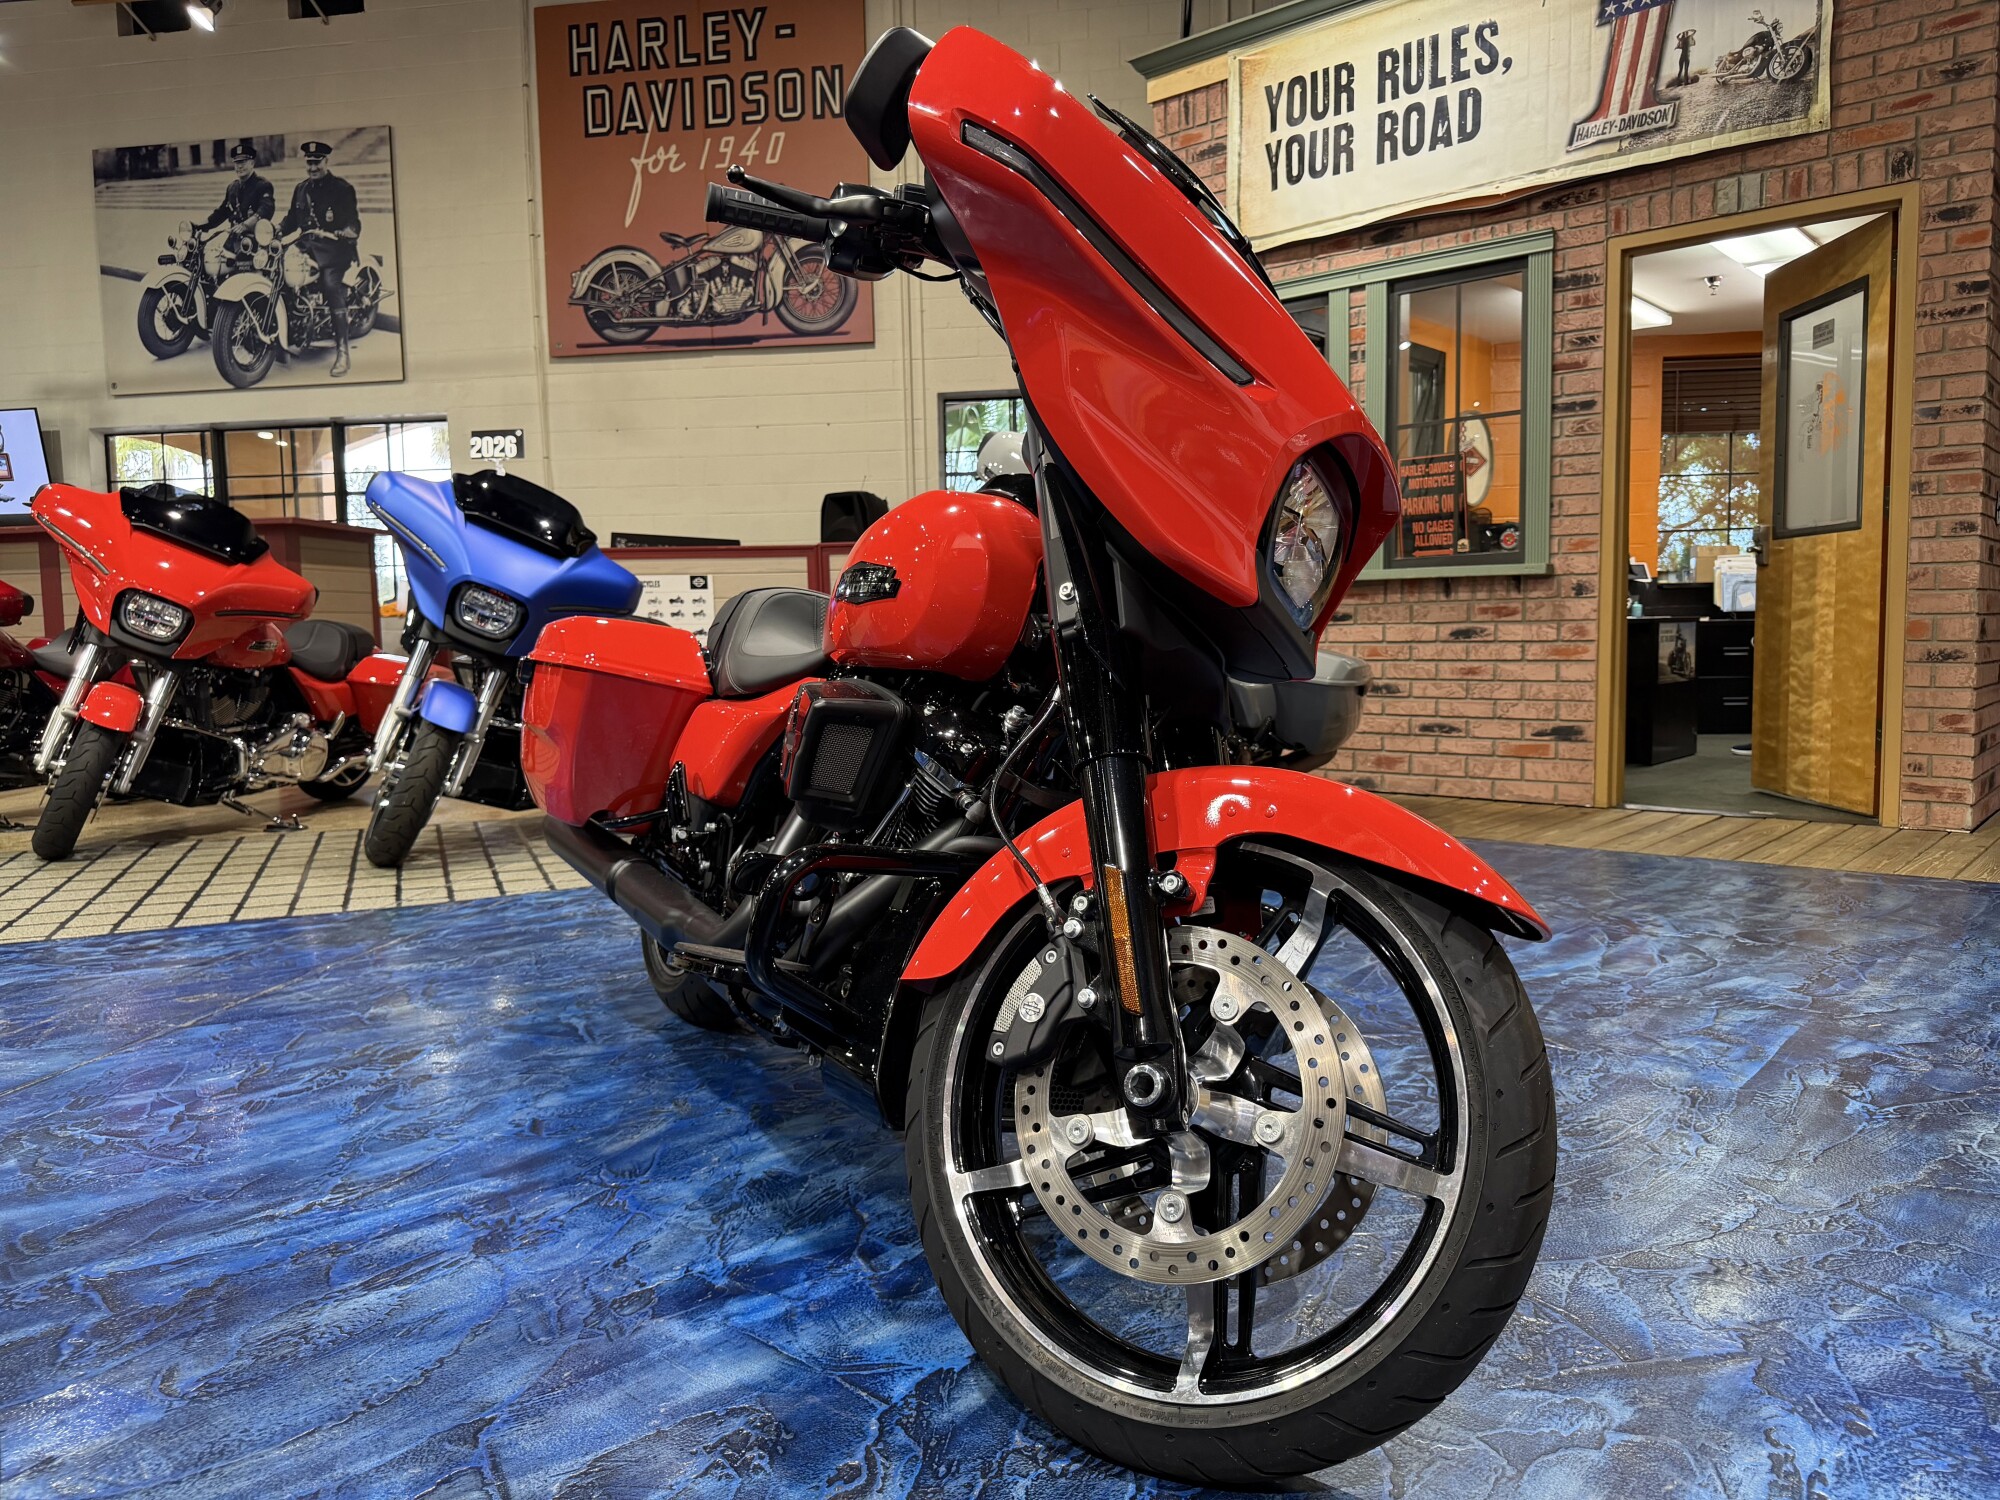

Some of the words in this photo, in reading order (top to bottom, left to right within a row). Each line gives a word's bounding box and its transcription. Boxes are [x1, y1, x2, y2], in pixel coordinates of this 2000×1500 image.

[1264, 61, 1355, 133] YOUR
[1377, 18, 1513, 104] RULES,
[584, 64, 844, 138] DAVIDSON
[1575, 106, 1671, 143] HARLEY-DAVIDSON
[1264, 122, 1354, 192] YOUR
[1376, 87, 1482, 165] ROAD
[625, 88, 687, 229] for
[700, 127, 785, 170] 1940
[470, 435, 517, 458] 2026
[1400, 461, 1463, 477] HARLEY-DAVIDS
[1408, 475, 1455, 491] MOTORCYCLE
[1402, 495, 1439, 516] PARKING
[1412, 521, 1424, 534] NO
[1426, 519, 1455, 533] CAGES
[1414, 533, 1454, 547] ALLOWED
